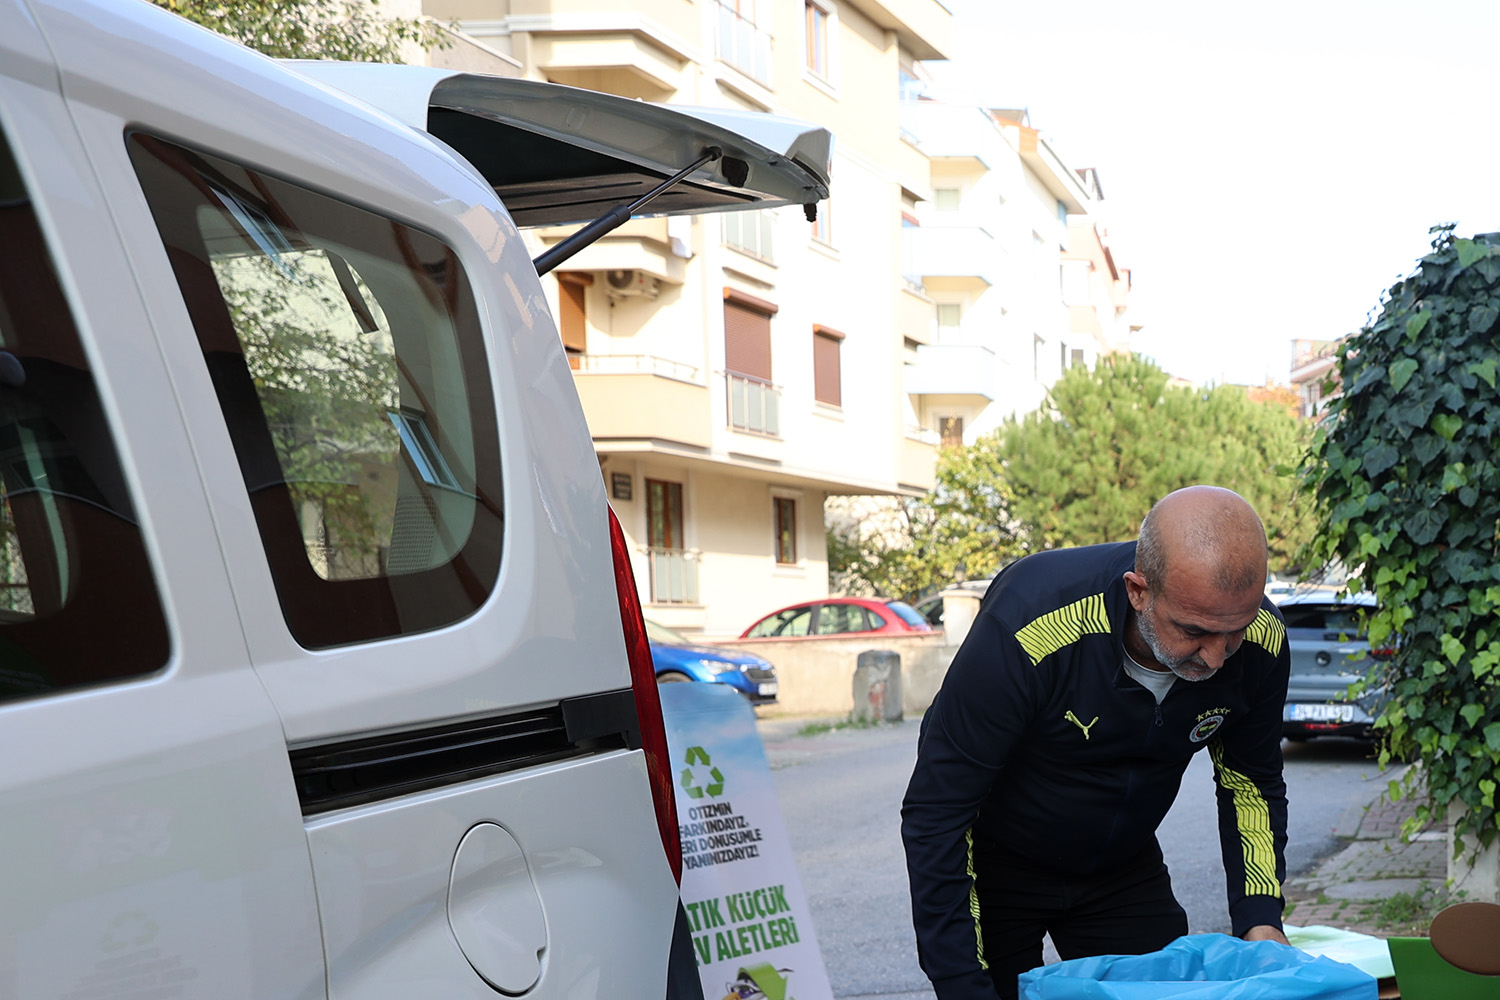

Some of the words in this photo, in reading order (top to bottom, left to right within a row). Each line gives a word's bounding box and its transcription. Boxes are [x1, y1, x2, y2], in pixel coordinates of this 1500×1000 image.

[681, 839, 698, 855] ERİ
[725, 884, 791, 924] KÜÇÜK
[694, 935, 711, 967] V
[716, 916, 799, 962] ALETLERİ
